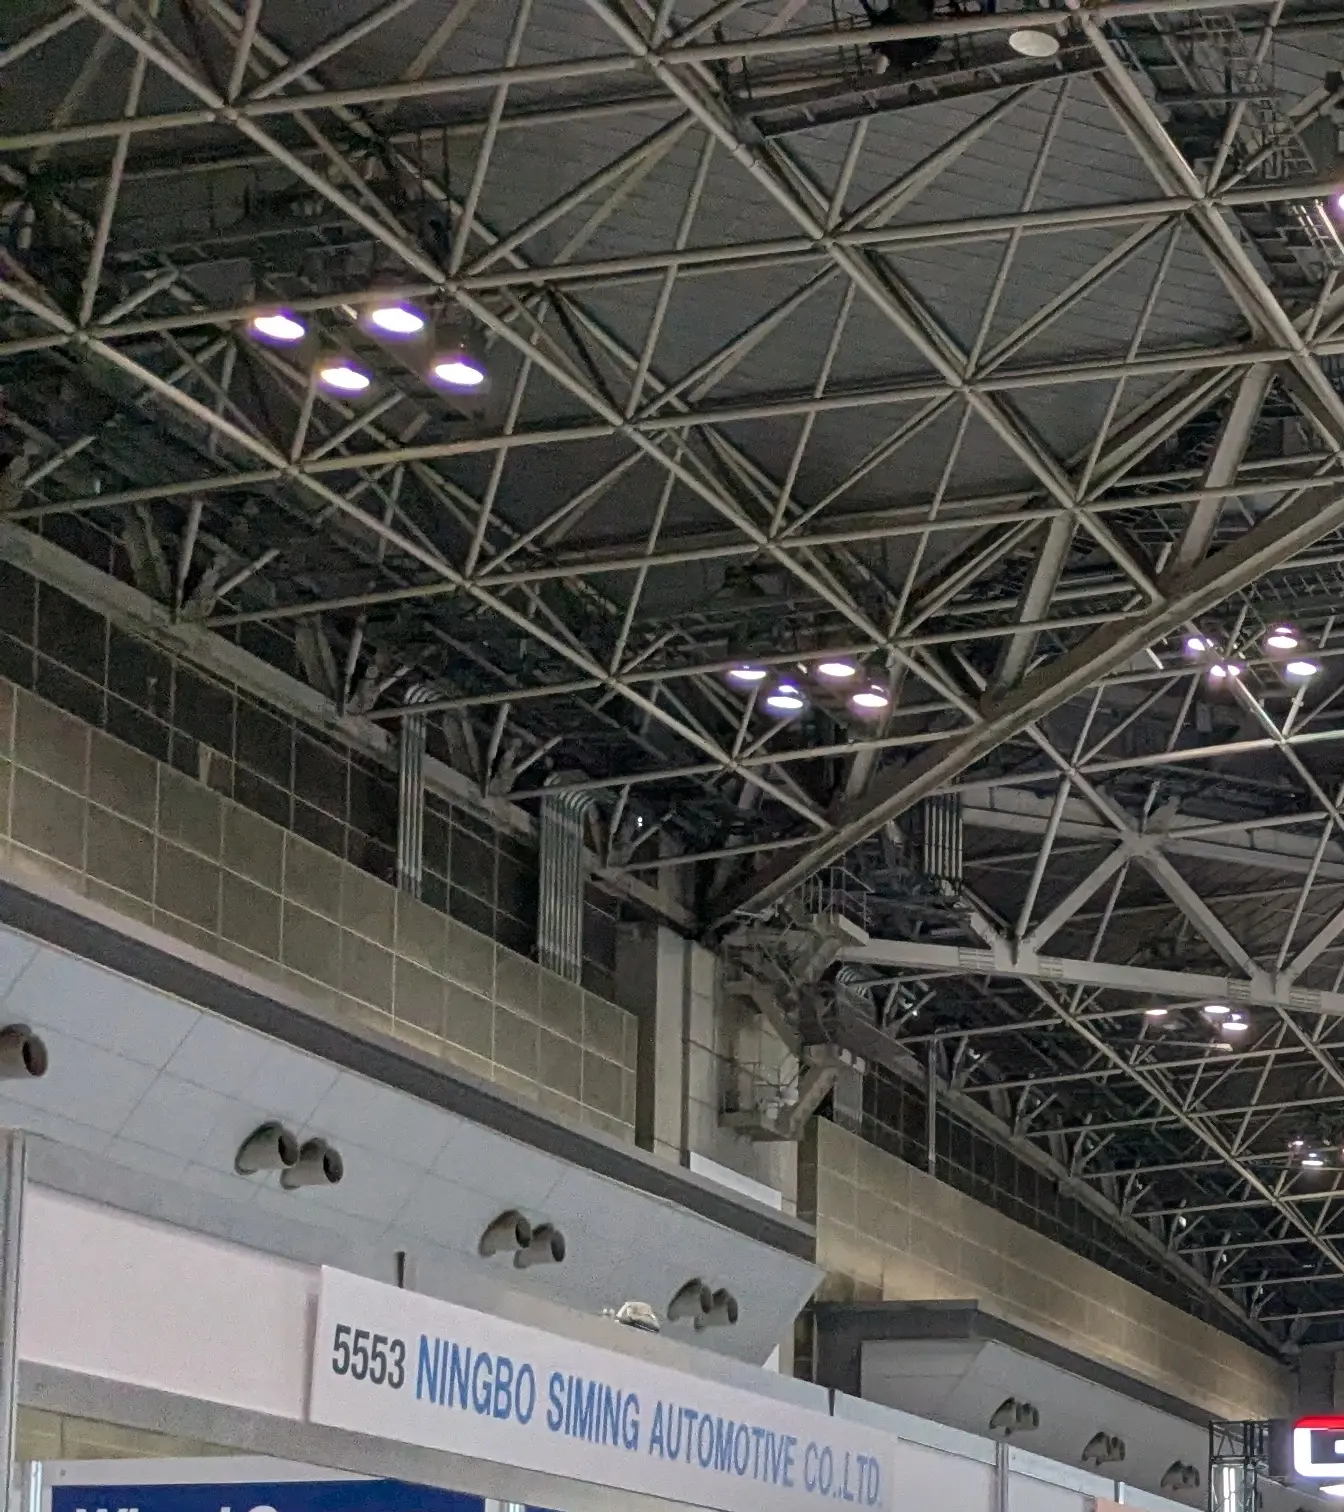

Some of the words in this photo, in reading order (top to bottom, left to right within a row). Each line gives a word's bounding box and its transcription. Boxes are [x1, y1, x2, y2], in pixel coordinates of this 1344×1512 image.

[332, 1323, 406, 1390] 5553
[416, 1333, 537, 1425] NINGBO
[546, 1371, 641, 1452] SIMING
[649, 1400, 798, 1488] AUTOMOTIVE
